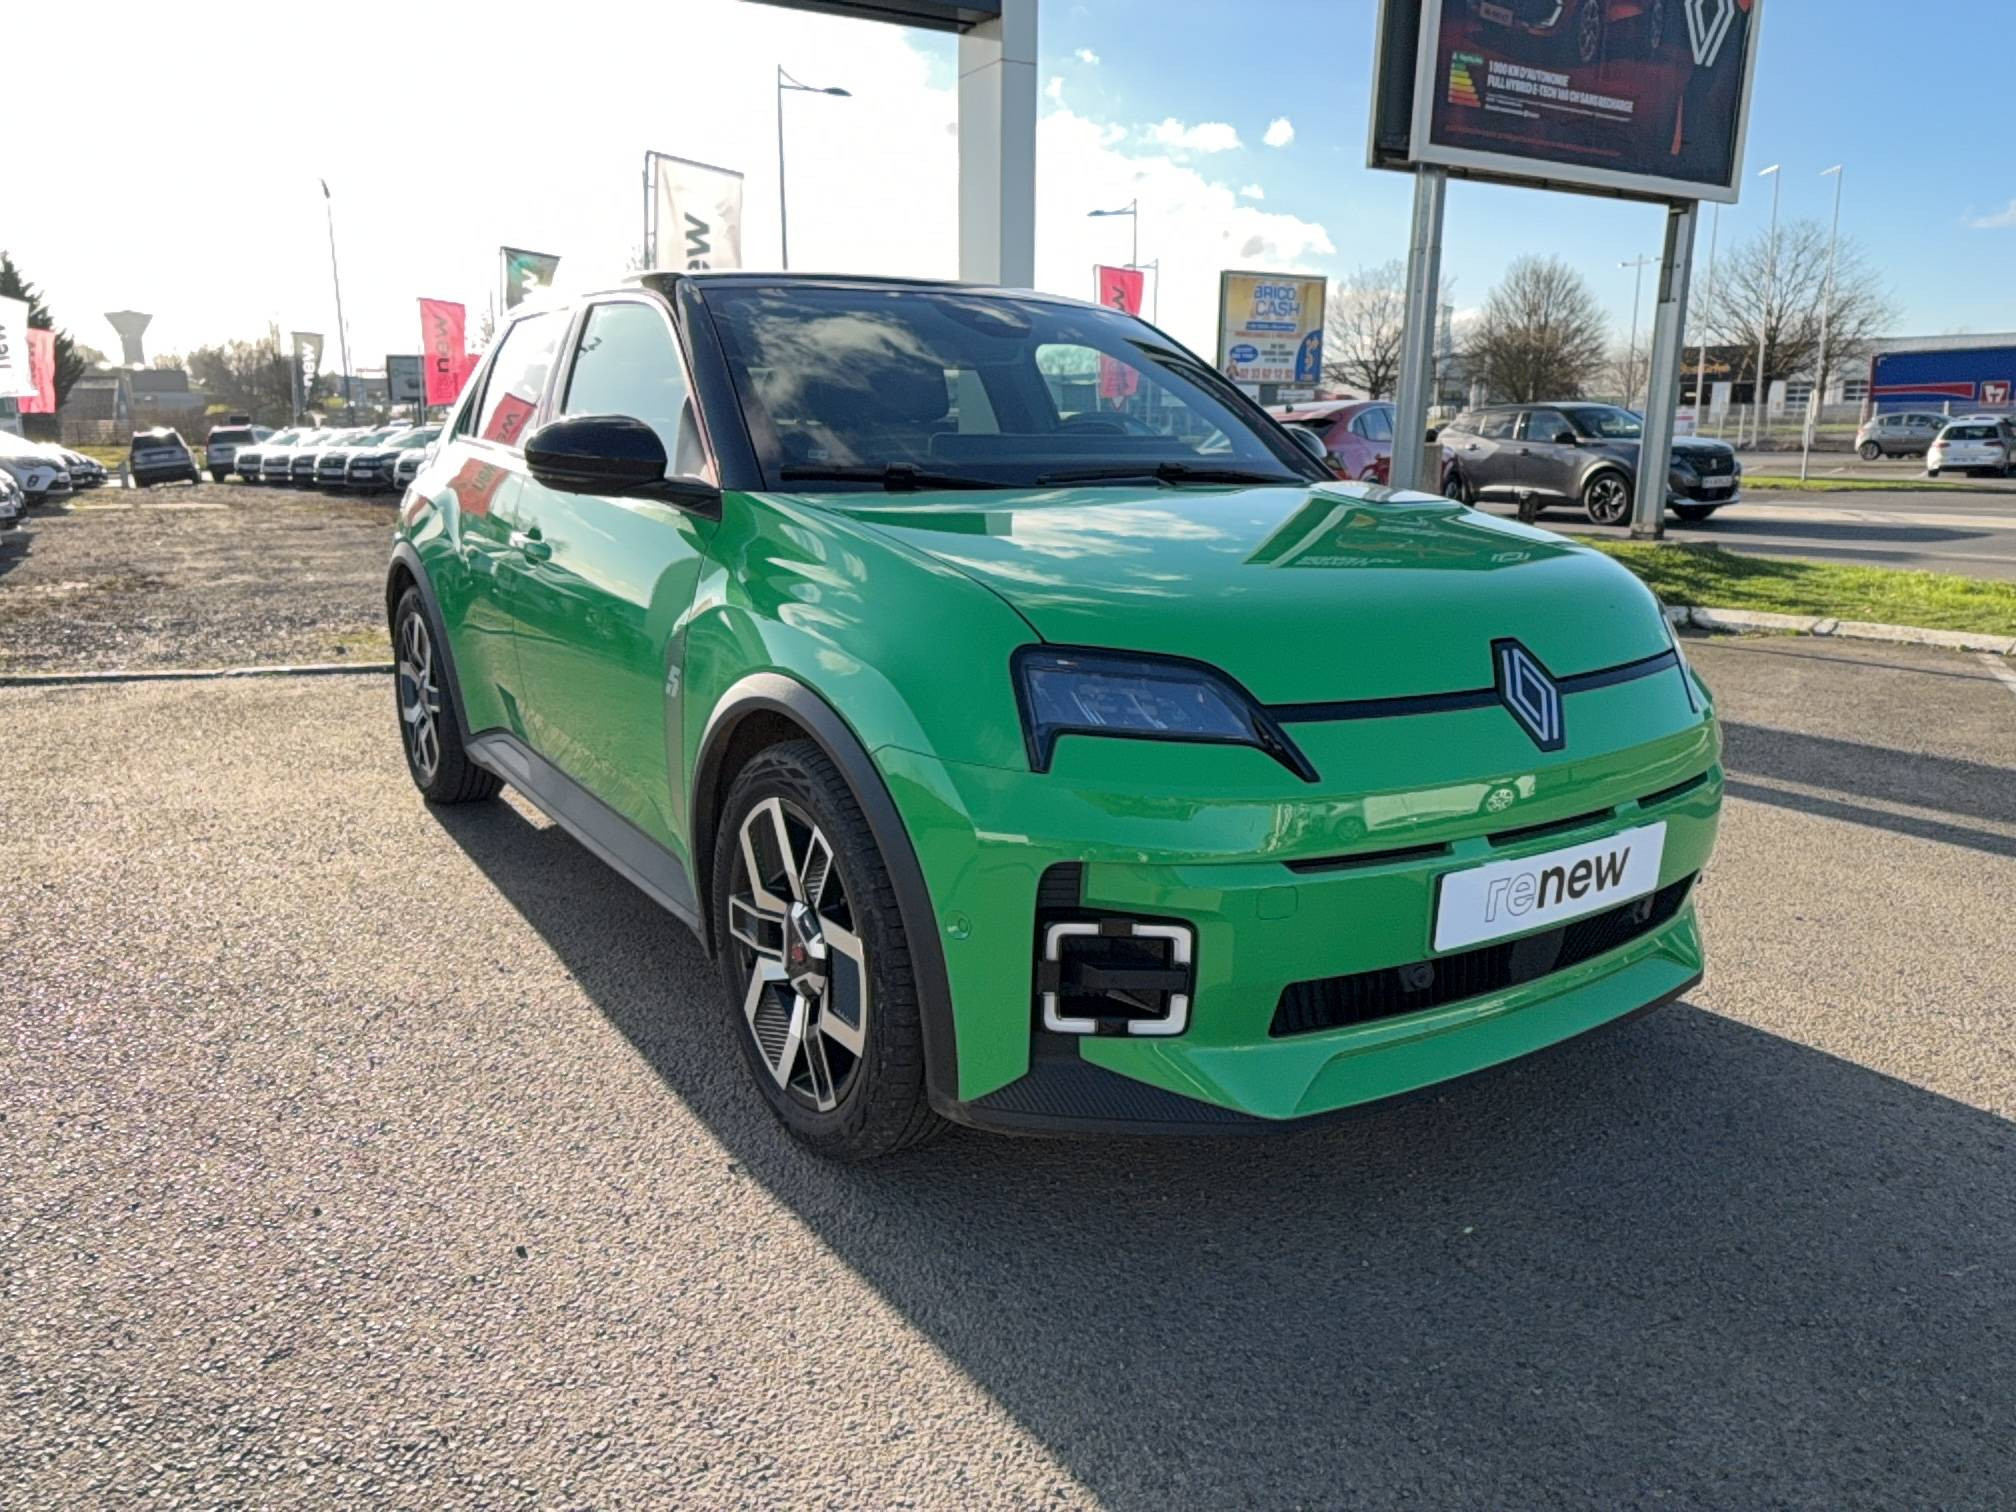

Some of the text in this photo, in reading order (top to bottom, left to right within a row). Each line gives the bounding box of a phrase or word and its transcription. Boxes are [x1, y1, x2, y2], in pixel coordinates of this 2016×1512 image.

[1487, 73, 1504, 90] FULL
[1505, 76, 1531, 95] HYBRID
[1254, 285, 1296, 300] BRICO
[1256, 300, 1300, 316] CASH
[1484, 846, 1632, 923] renew
